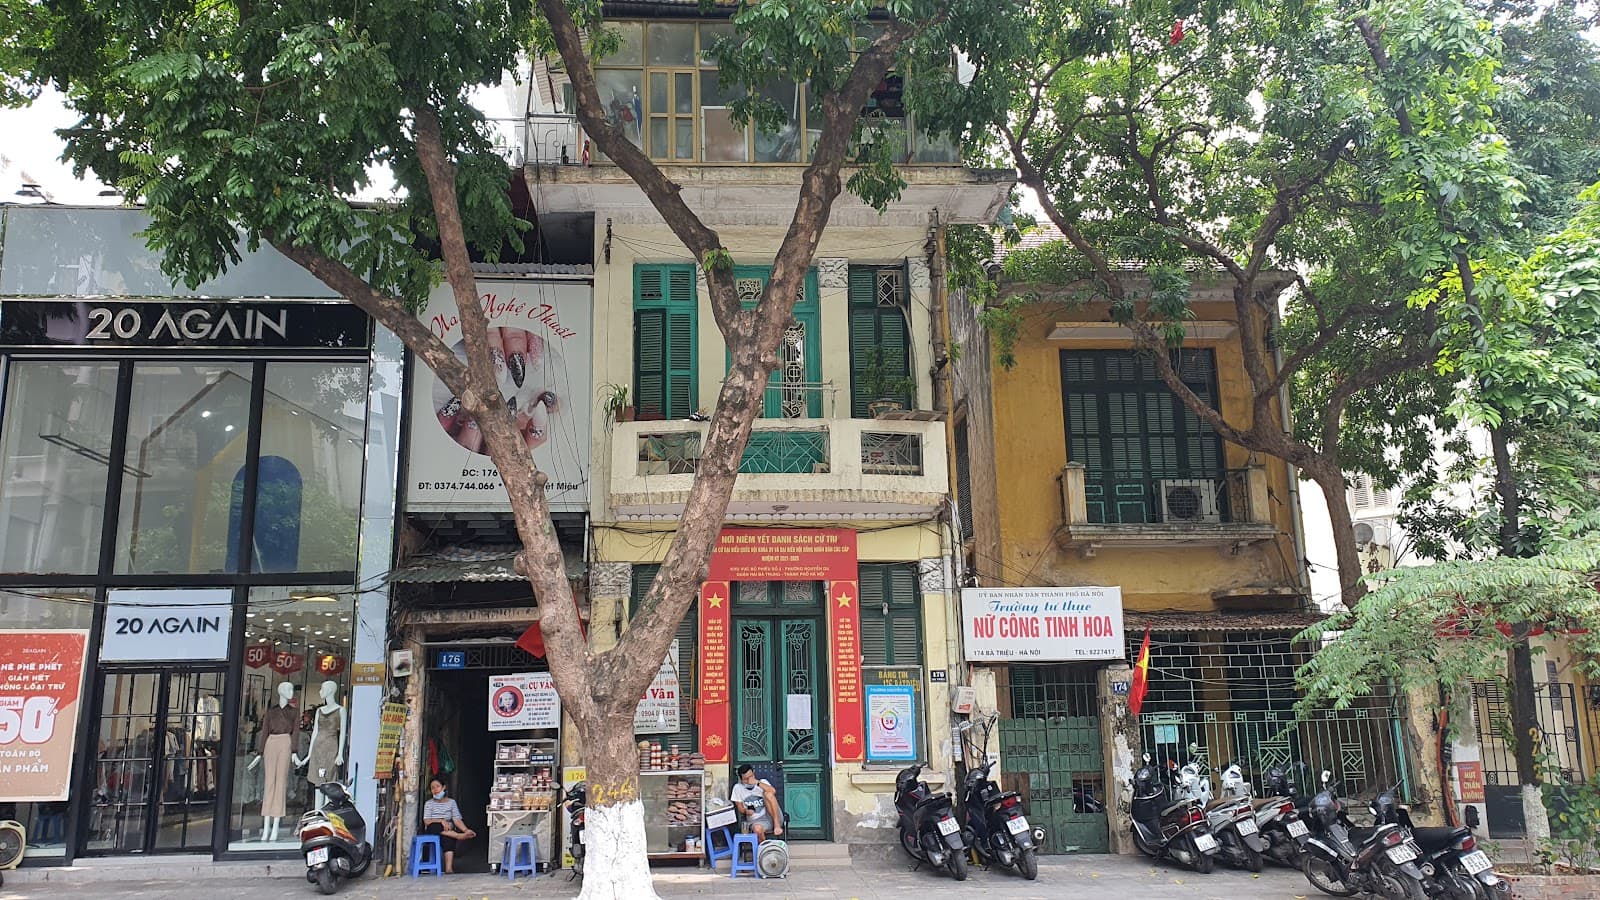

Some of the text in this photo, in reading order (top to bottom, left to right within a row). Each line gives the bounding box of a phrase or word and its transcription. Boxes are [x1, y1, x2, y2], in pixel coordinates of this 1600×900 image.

[480, 293, 526, 319] Nghệ
[86, 308, 287, 340] 20 AGAIN
[462, 468, 498, 477] ĐC: 176
[418, 482, 432, 490] ĐT:
[434, 482, 495, 490] 0374.744.066
[772, 535, 792, 544] DANH
[988, 600, 1038, 614] Trường
[1062, 600, 1092, 614] thục
[116, 616, 220, 634] 20 AGAIN
[974, 612, 1112, 638] NỮ CÔNG TINH HOA
[443, 654, 460, 663] 176
[0, 681, 21, 690] HÔNG
[1114, 682, 1127, 692] 174
[650, 687, 674, 699] Vân
